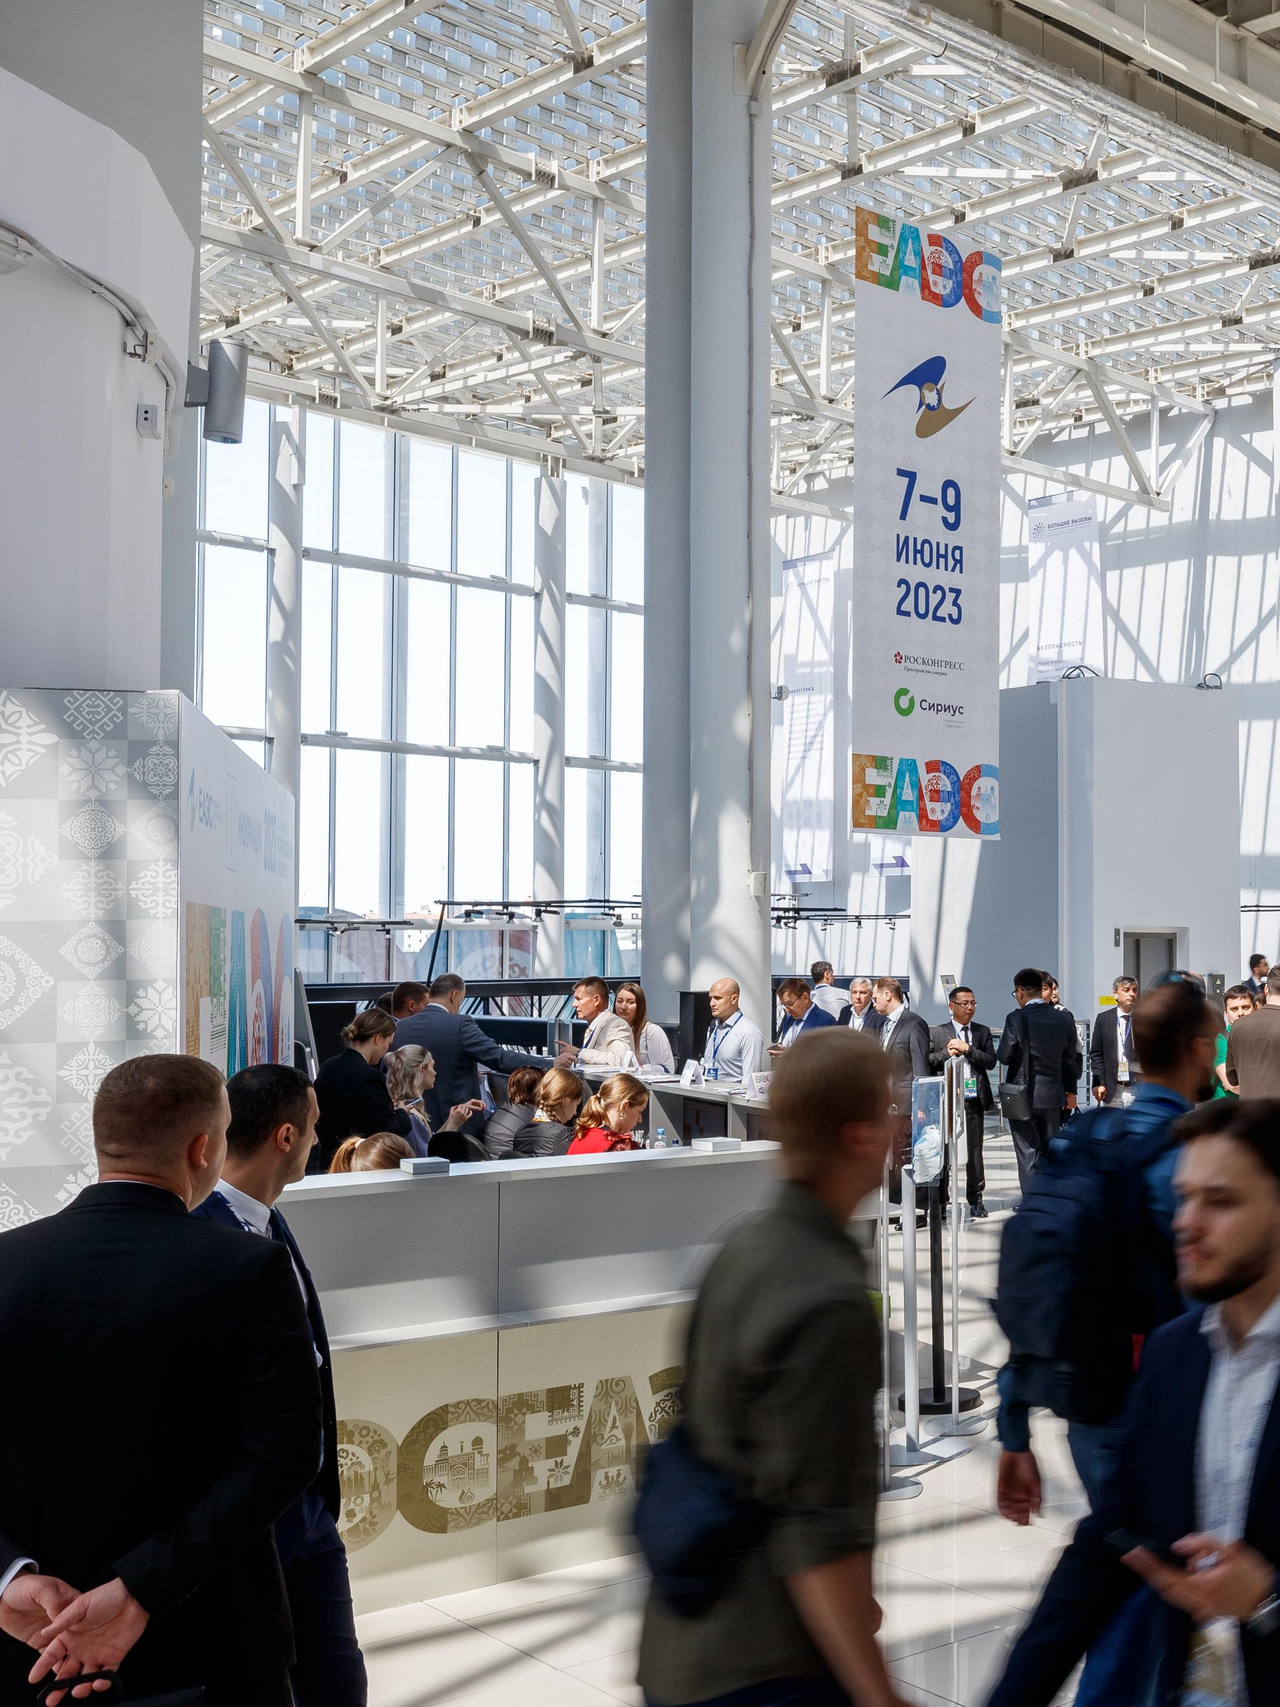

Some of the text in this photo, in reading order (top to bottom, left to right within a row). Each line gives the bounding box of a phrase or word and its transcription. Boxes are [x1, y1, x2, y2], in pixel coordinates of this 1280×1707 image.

[855, 206, 1002, 325] ЕАЭС
[896, 533, 964, 575] ИЮНЯ
[896, 577, 963, 626] 2023
[904, 655, 965, 671] РОСКОНГРЕСС
[919, 699, 964, 717] Сириус
[852, 753, 1000, 836] ЕАЭС
